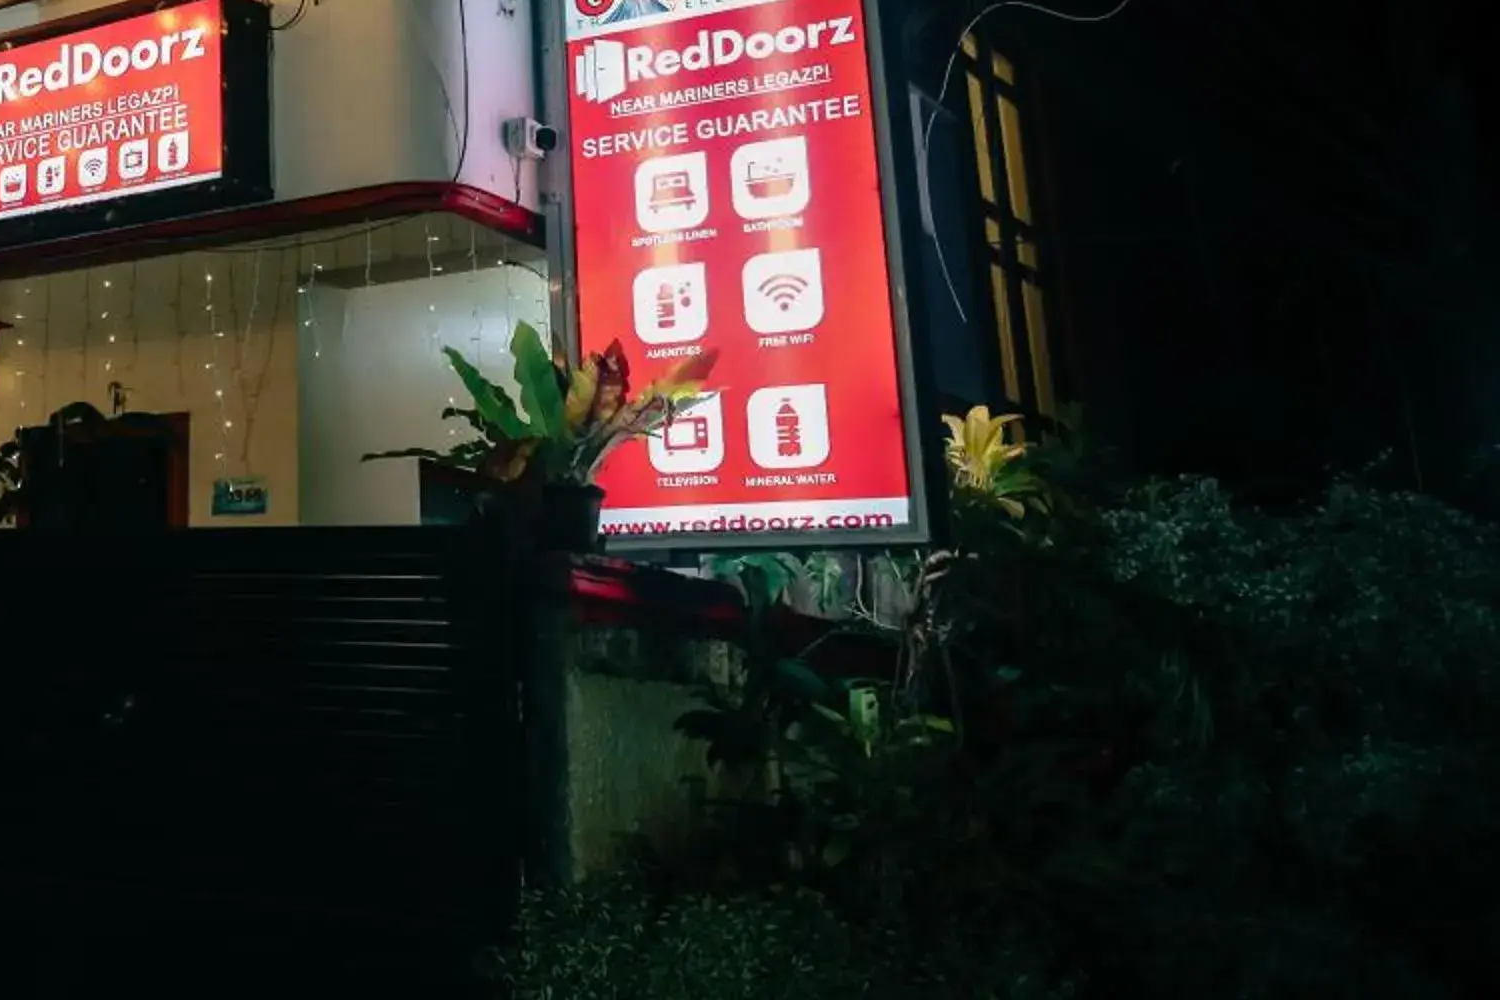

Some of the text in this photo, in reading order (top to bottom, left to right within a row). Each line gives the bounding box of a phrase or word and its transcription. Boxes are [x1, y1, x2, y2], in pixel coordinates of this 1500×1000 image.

[628, 16, 855, 81] RedDoorz
[611, 65, 830, 115] NEAR MARINERS LEGAZPI
[20, 104, 103, 134] MARINERS
[107, 84, 180, 114] LEGAZPI
[57, 104, 189, 151] GUARANTEE
[582, 94, 861, 159] SERVICE GUARANTEE
[743, 218, 803, 232] BATHM
[631, 234, 684, 247] SPOTLS
[759, 335, 787, 348] FREE
[646, 345, 702, 358] AMENITIES
[657, 475, 719, 487] TELEVISION
[745, 473, 837, 488] MINERAL WATER
[601, 512, 894, 536] www.reddoorz.com
